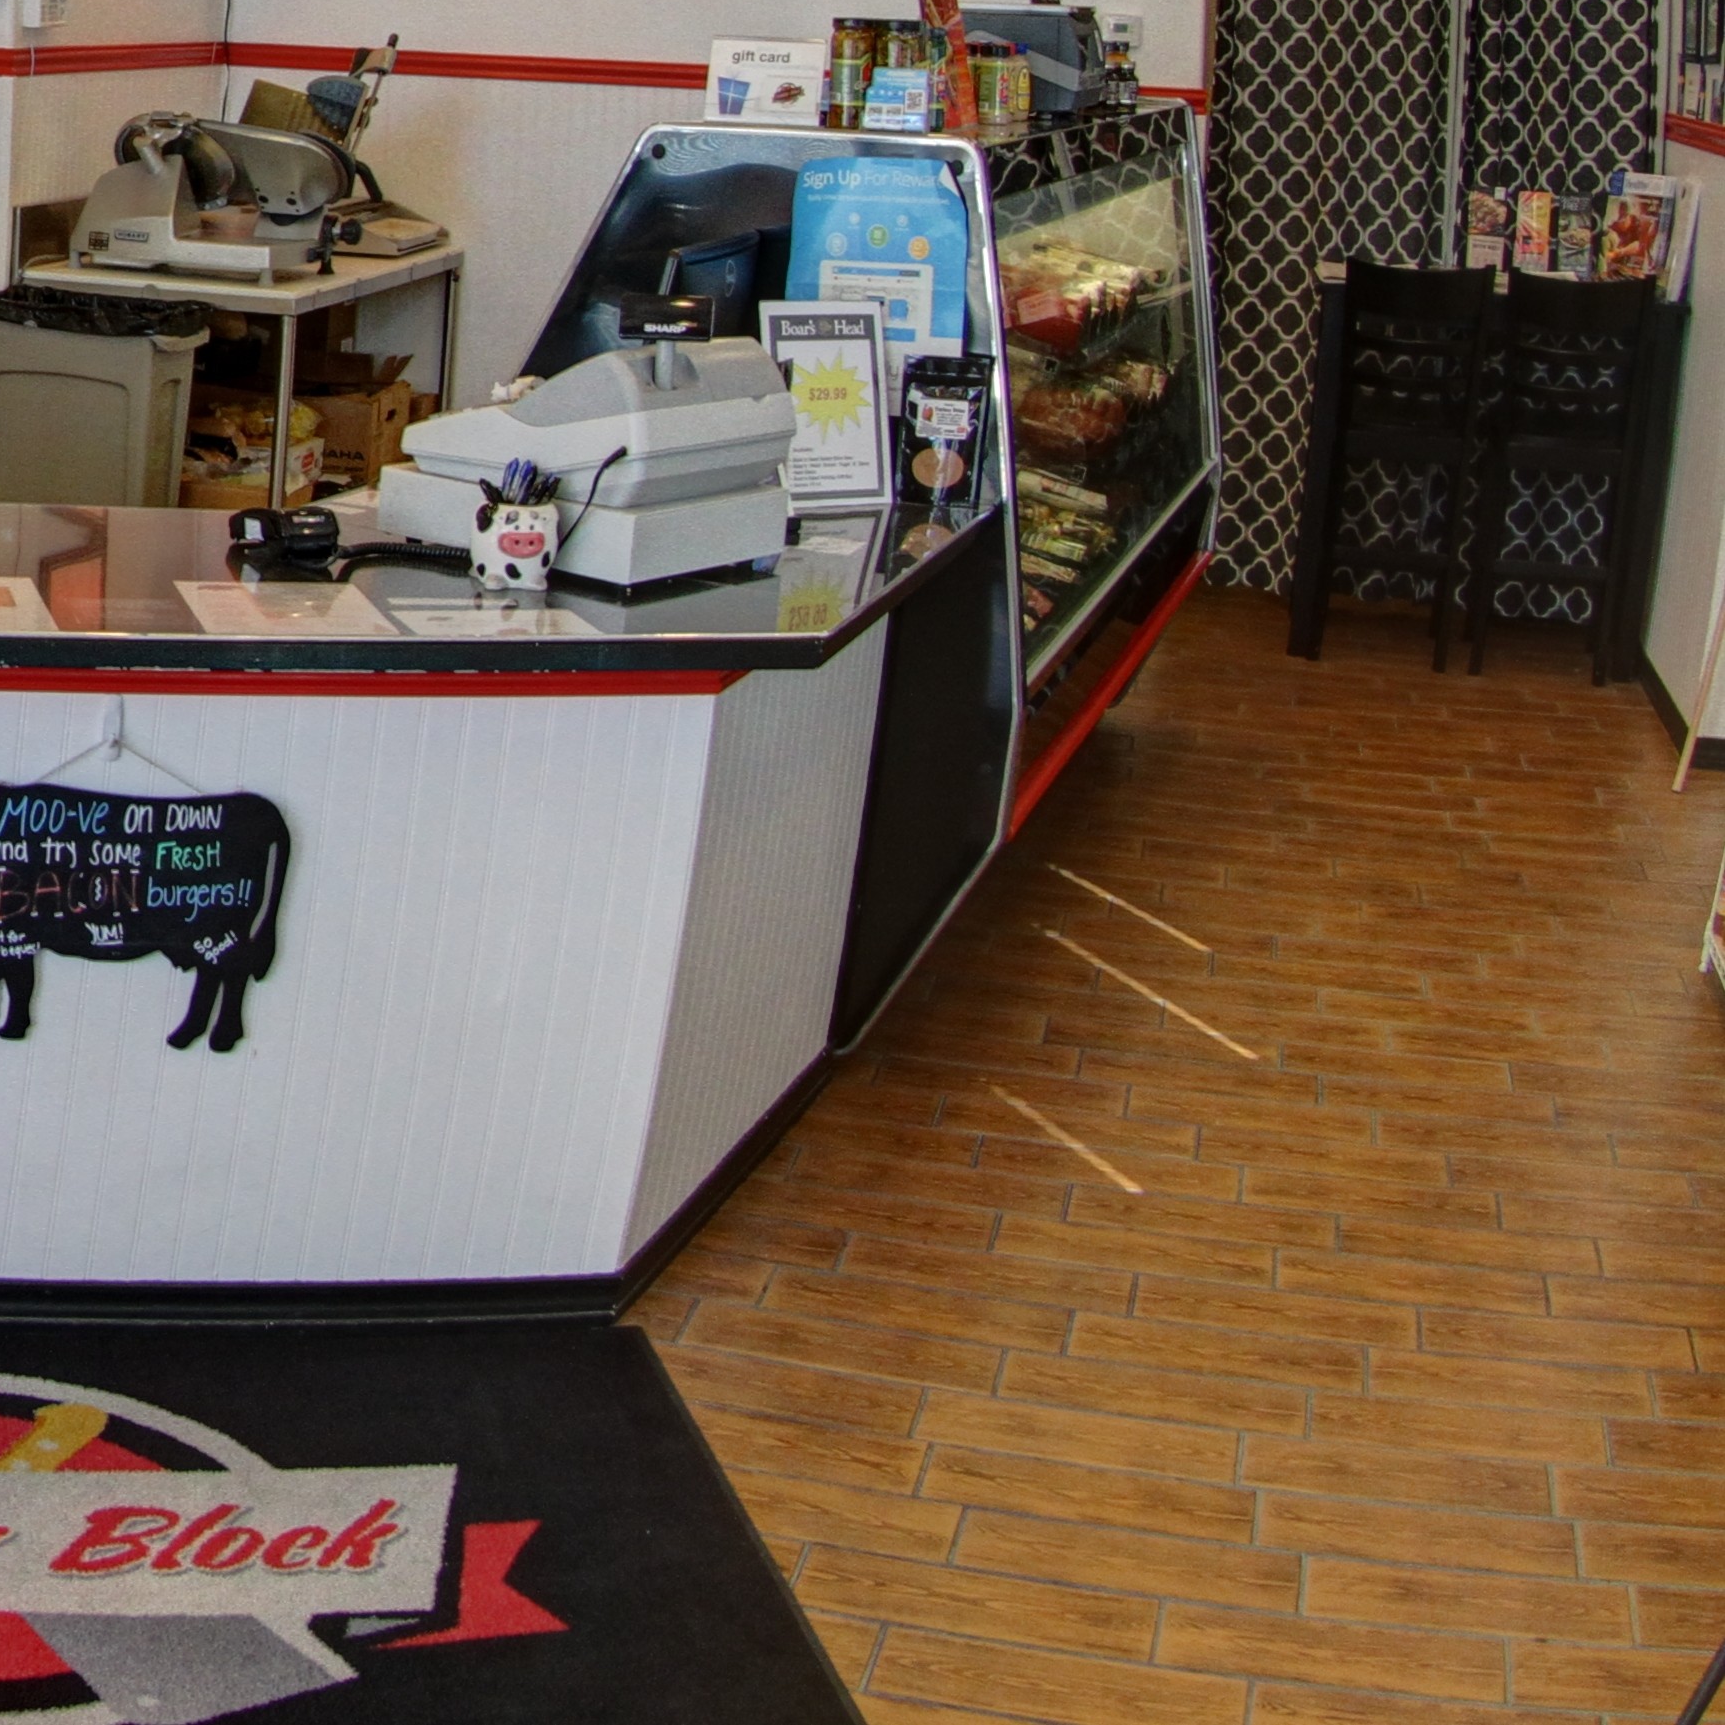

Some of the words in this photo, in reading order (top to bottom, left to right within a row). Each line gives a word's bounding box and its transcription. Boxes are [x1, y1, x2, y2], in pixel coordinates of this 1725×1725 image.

[732, 50, 755, 64] gift
[759, 52, 791, 64] card
[803, 170, 834, 189] Sign
[838, 168, 862, 189] Up
[864, 170, 890, 185] For
[894, 171, 937, 187] Rewar
[643, 322, 686, 334] SHARP
[780, 319, 816, 336] Boar's
[834, 320, 865, 336] Head
[808, 387, 847, 401] $29.99
[124, 805, 153, 833] on
[165, 804, 222, 830] DOWN
[41, 837, 77, 868] try
[147, 879, 252, 922] burgers!!
[7, 930, 27, 945] for
[85, 921, 125, 945] YUM!
[193, 936, 213, 954] so
[204, 930, 239, 965] good!
[46, 1496, 409, 1576] Block
